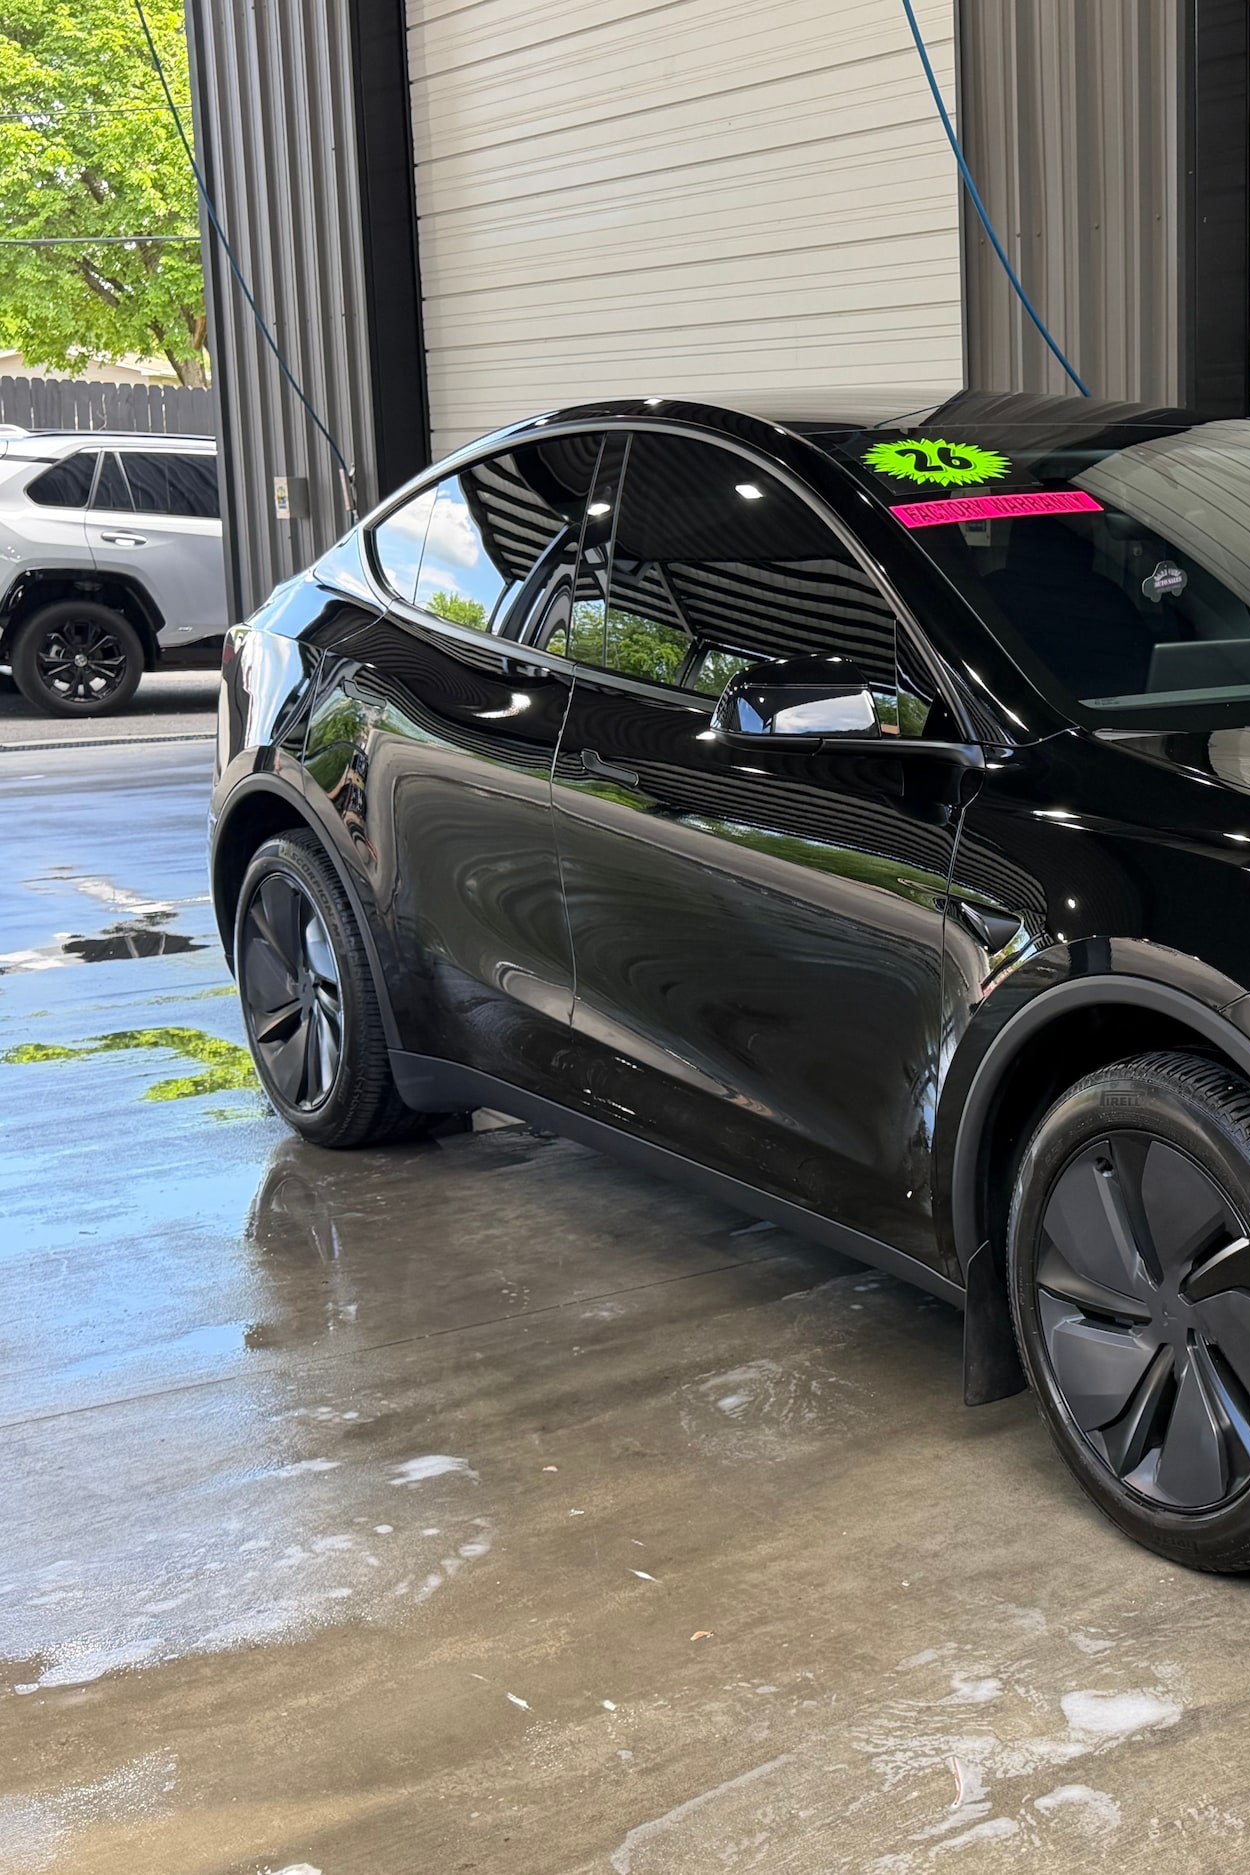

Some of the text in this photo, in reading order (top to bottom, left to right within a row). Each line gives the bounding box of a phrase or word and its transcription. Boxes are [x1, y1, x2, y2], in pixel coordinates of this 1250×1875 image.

[895, 447, 973, 473] 26
[902, 493, 1086, 523] FACTORY WARRANTY
[291, 852, 334, 917] SCORPION
[1100, 1090, 1147, 1106] PIRELL
